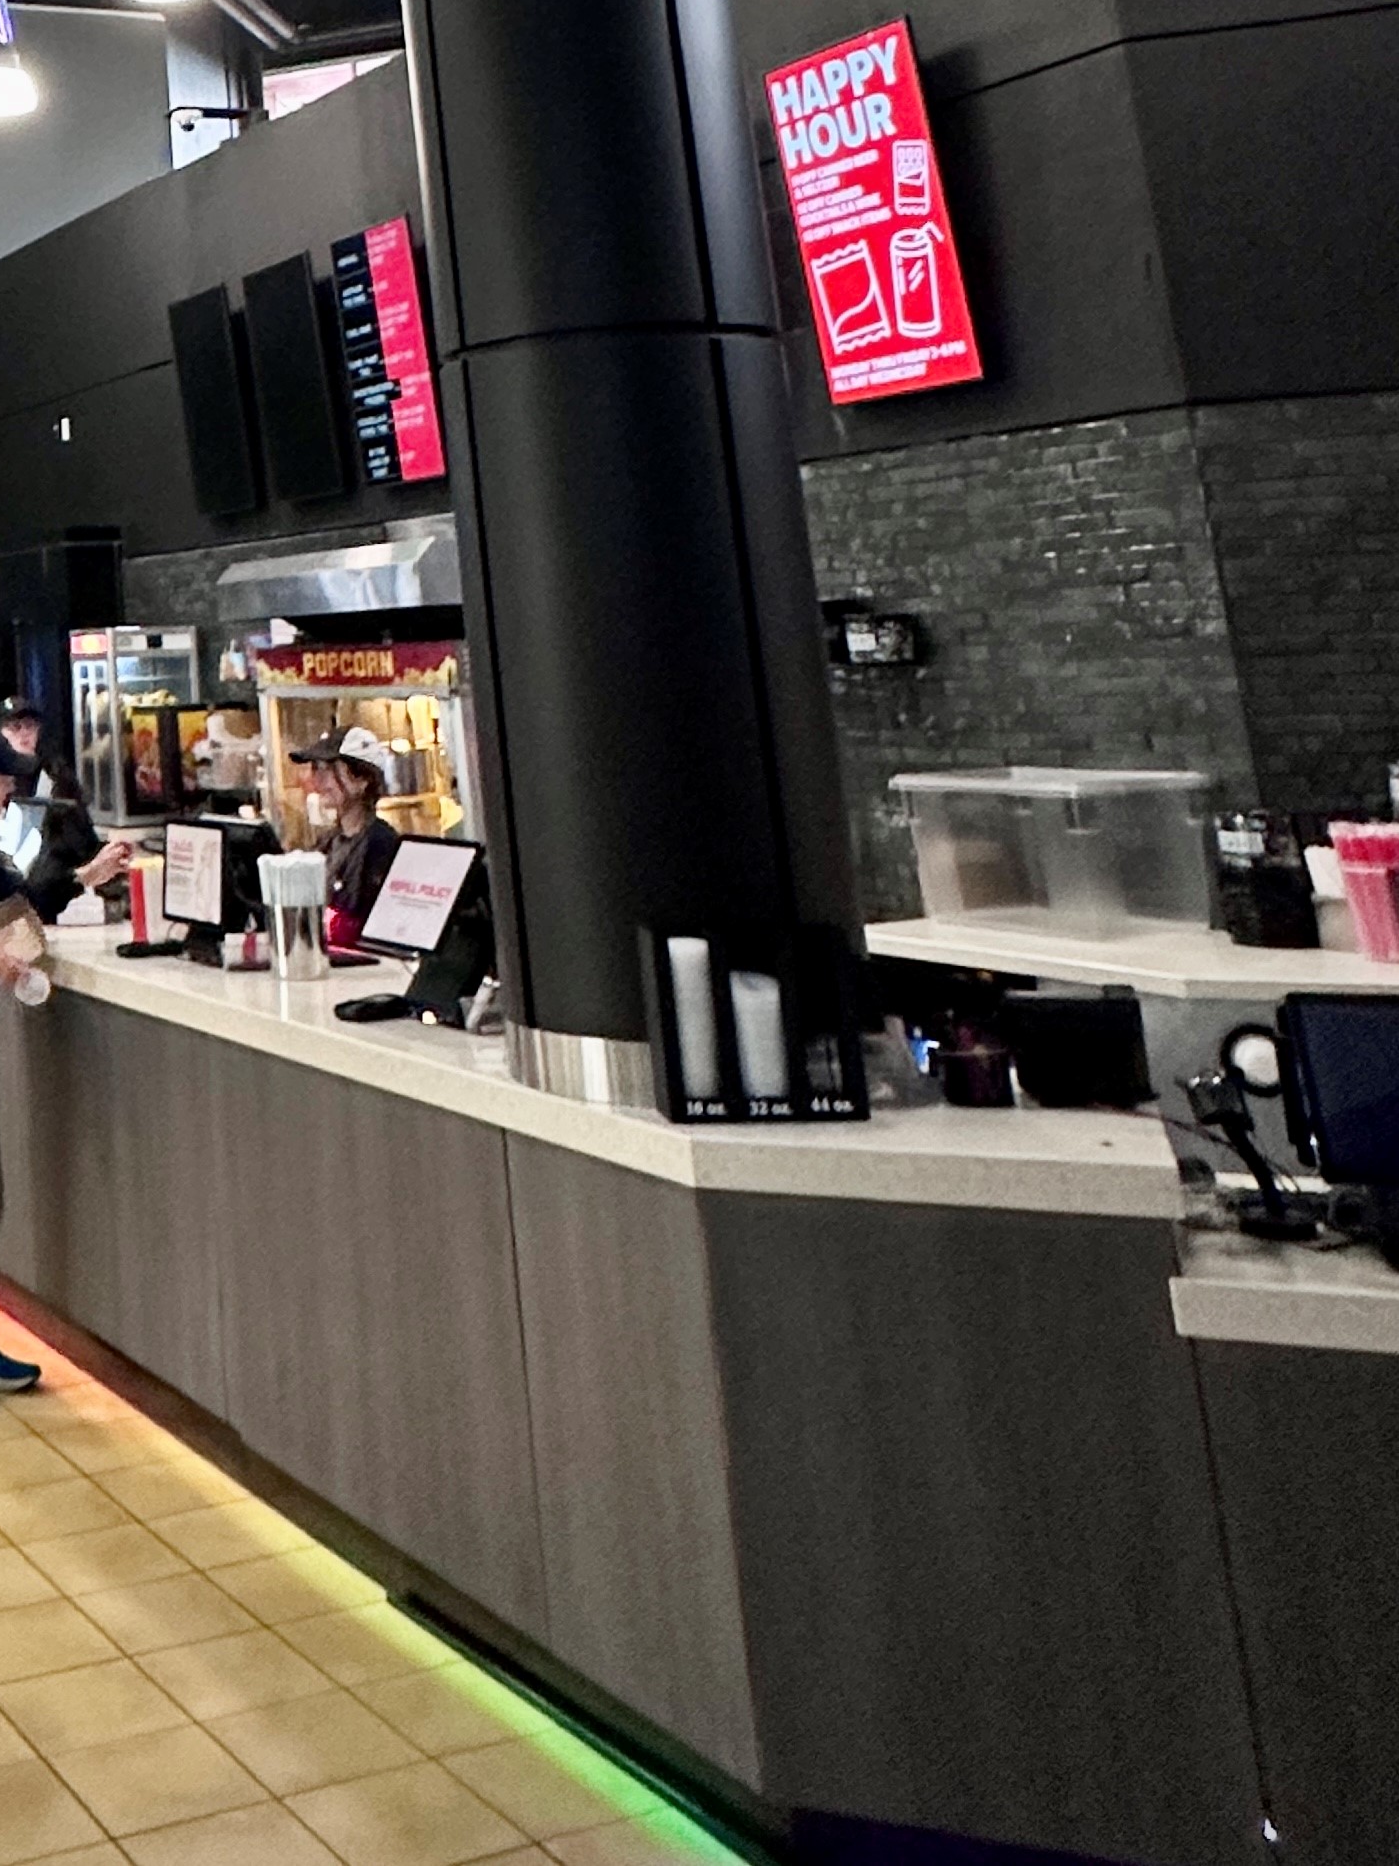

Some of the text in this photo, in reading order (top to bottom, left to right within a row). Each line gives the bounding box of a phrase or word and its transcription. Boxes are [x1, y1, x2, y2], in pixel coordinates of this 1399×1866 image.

[771, 35, 898, 124] HAPPY
[780, 93, 898, 169] HOUR
[303, 651, 395, 678] POPCORN
